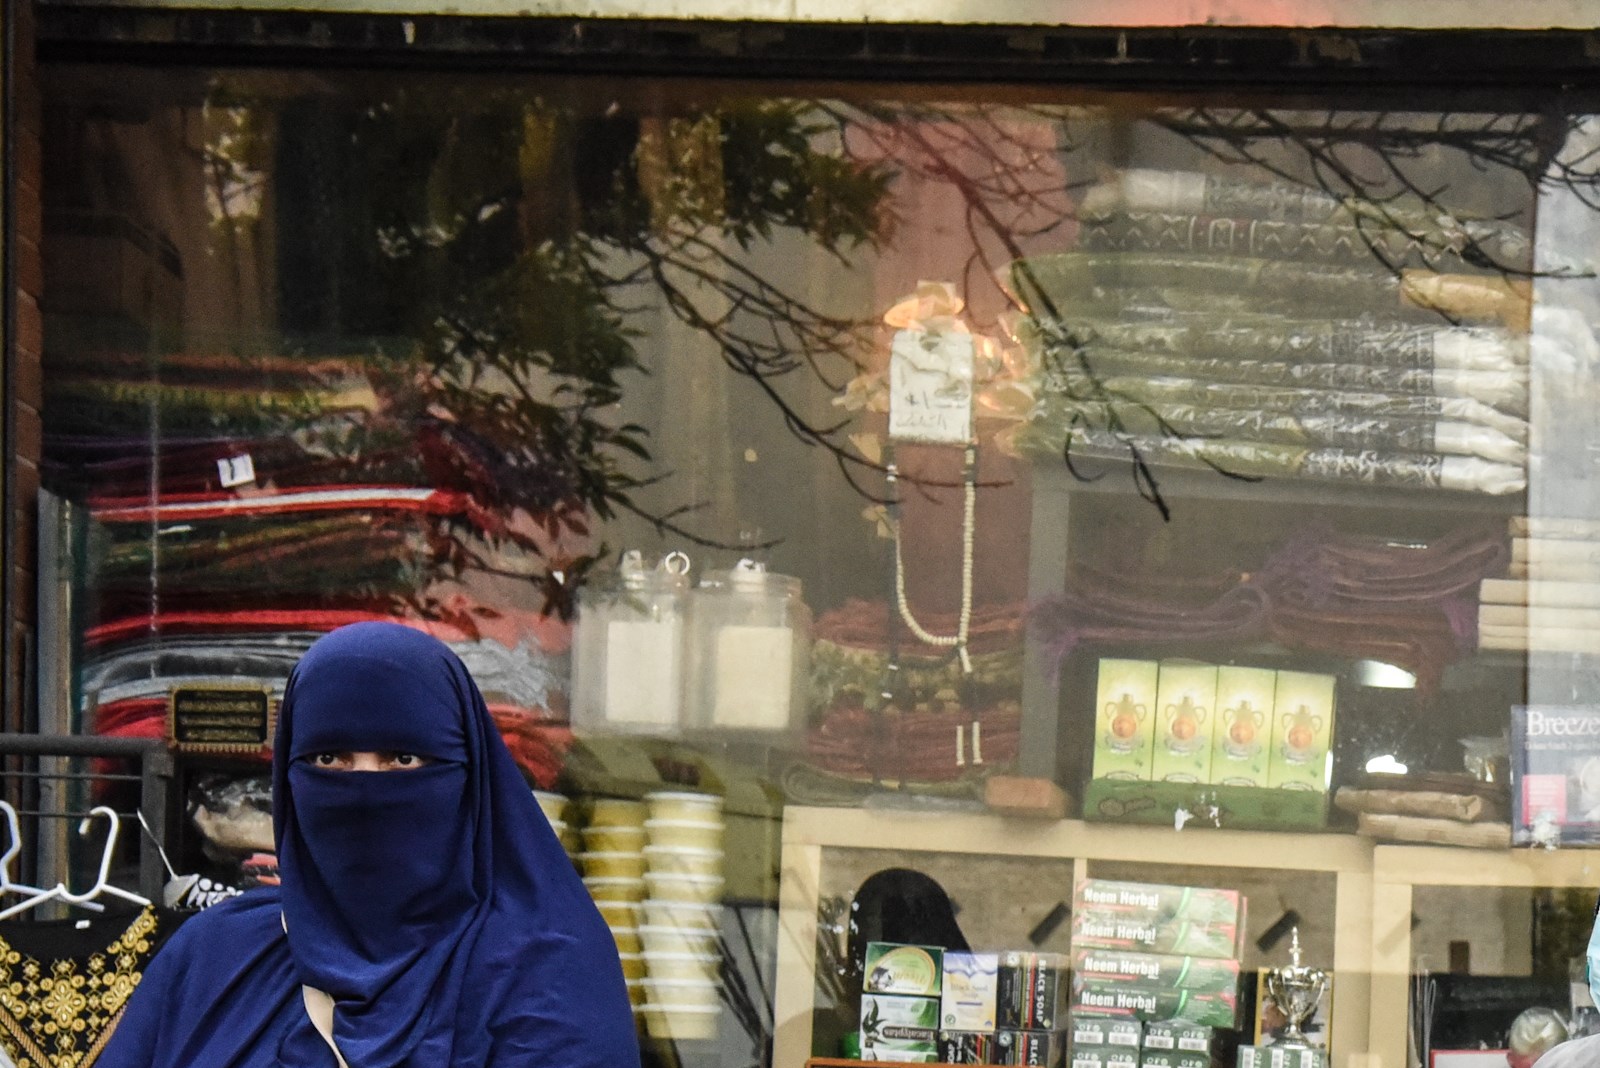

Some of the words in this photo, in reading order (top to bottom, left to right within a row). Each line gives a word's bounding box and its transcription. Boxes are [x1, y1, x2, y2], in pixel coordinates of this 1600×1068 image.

[1526, 711, 1600, 735] Breeze
[1085, 888, 1117, 903] Neem
[1120, 891, 1159, 906] Herbal
[1082, 923, 1113, 937] Neem
[1117, 926, 1156, 941] Herbal
[1085, 958, 1117, 972] Neem
[1121, 961, 1159, 976] Herbal
[1036, 959, 1047, 997] BLACK
[1036, 998, 1045, 1023] SOAP
[1082, 992, 1113, 1006] Neem
[1117, 995, 1156, 1010] Herbal
[1030, 1039, 1039, 1068] BLAC
